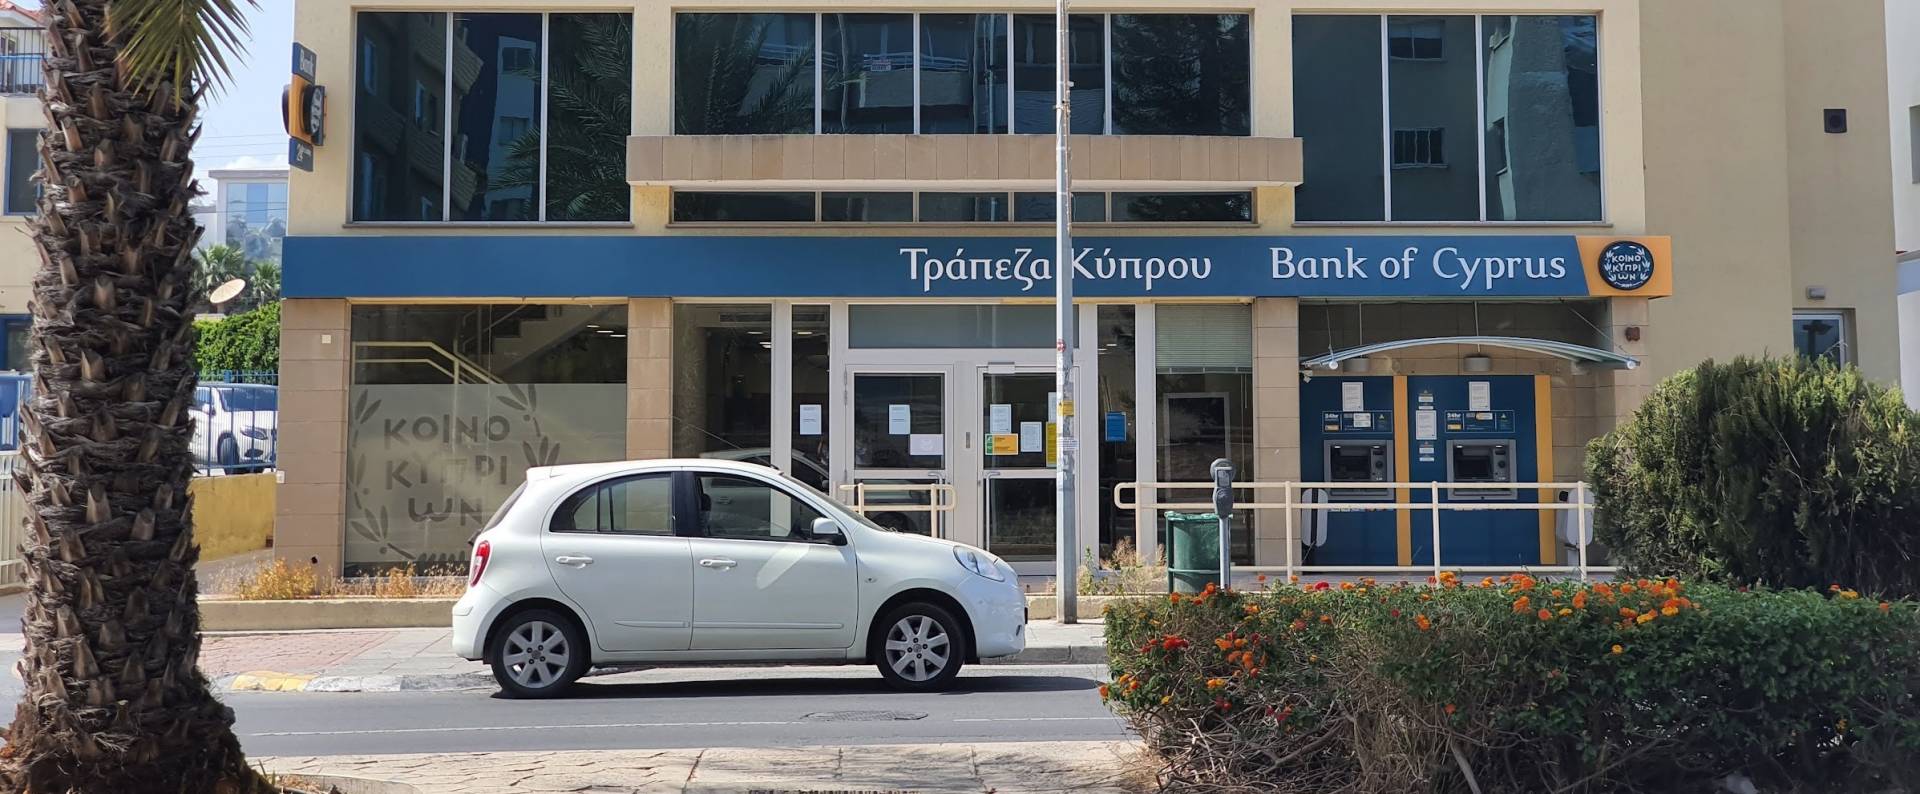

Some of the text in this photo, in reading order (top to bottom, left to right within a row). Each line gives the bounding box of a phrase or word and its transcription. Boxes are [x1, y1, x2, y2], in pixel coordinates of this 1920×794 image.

[899, 247, 1212, 292] Τράπεζα Κύπρου
[1270, 247, 1567, 290] Bank of Cyprus
